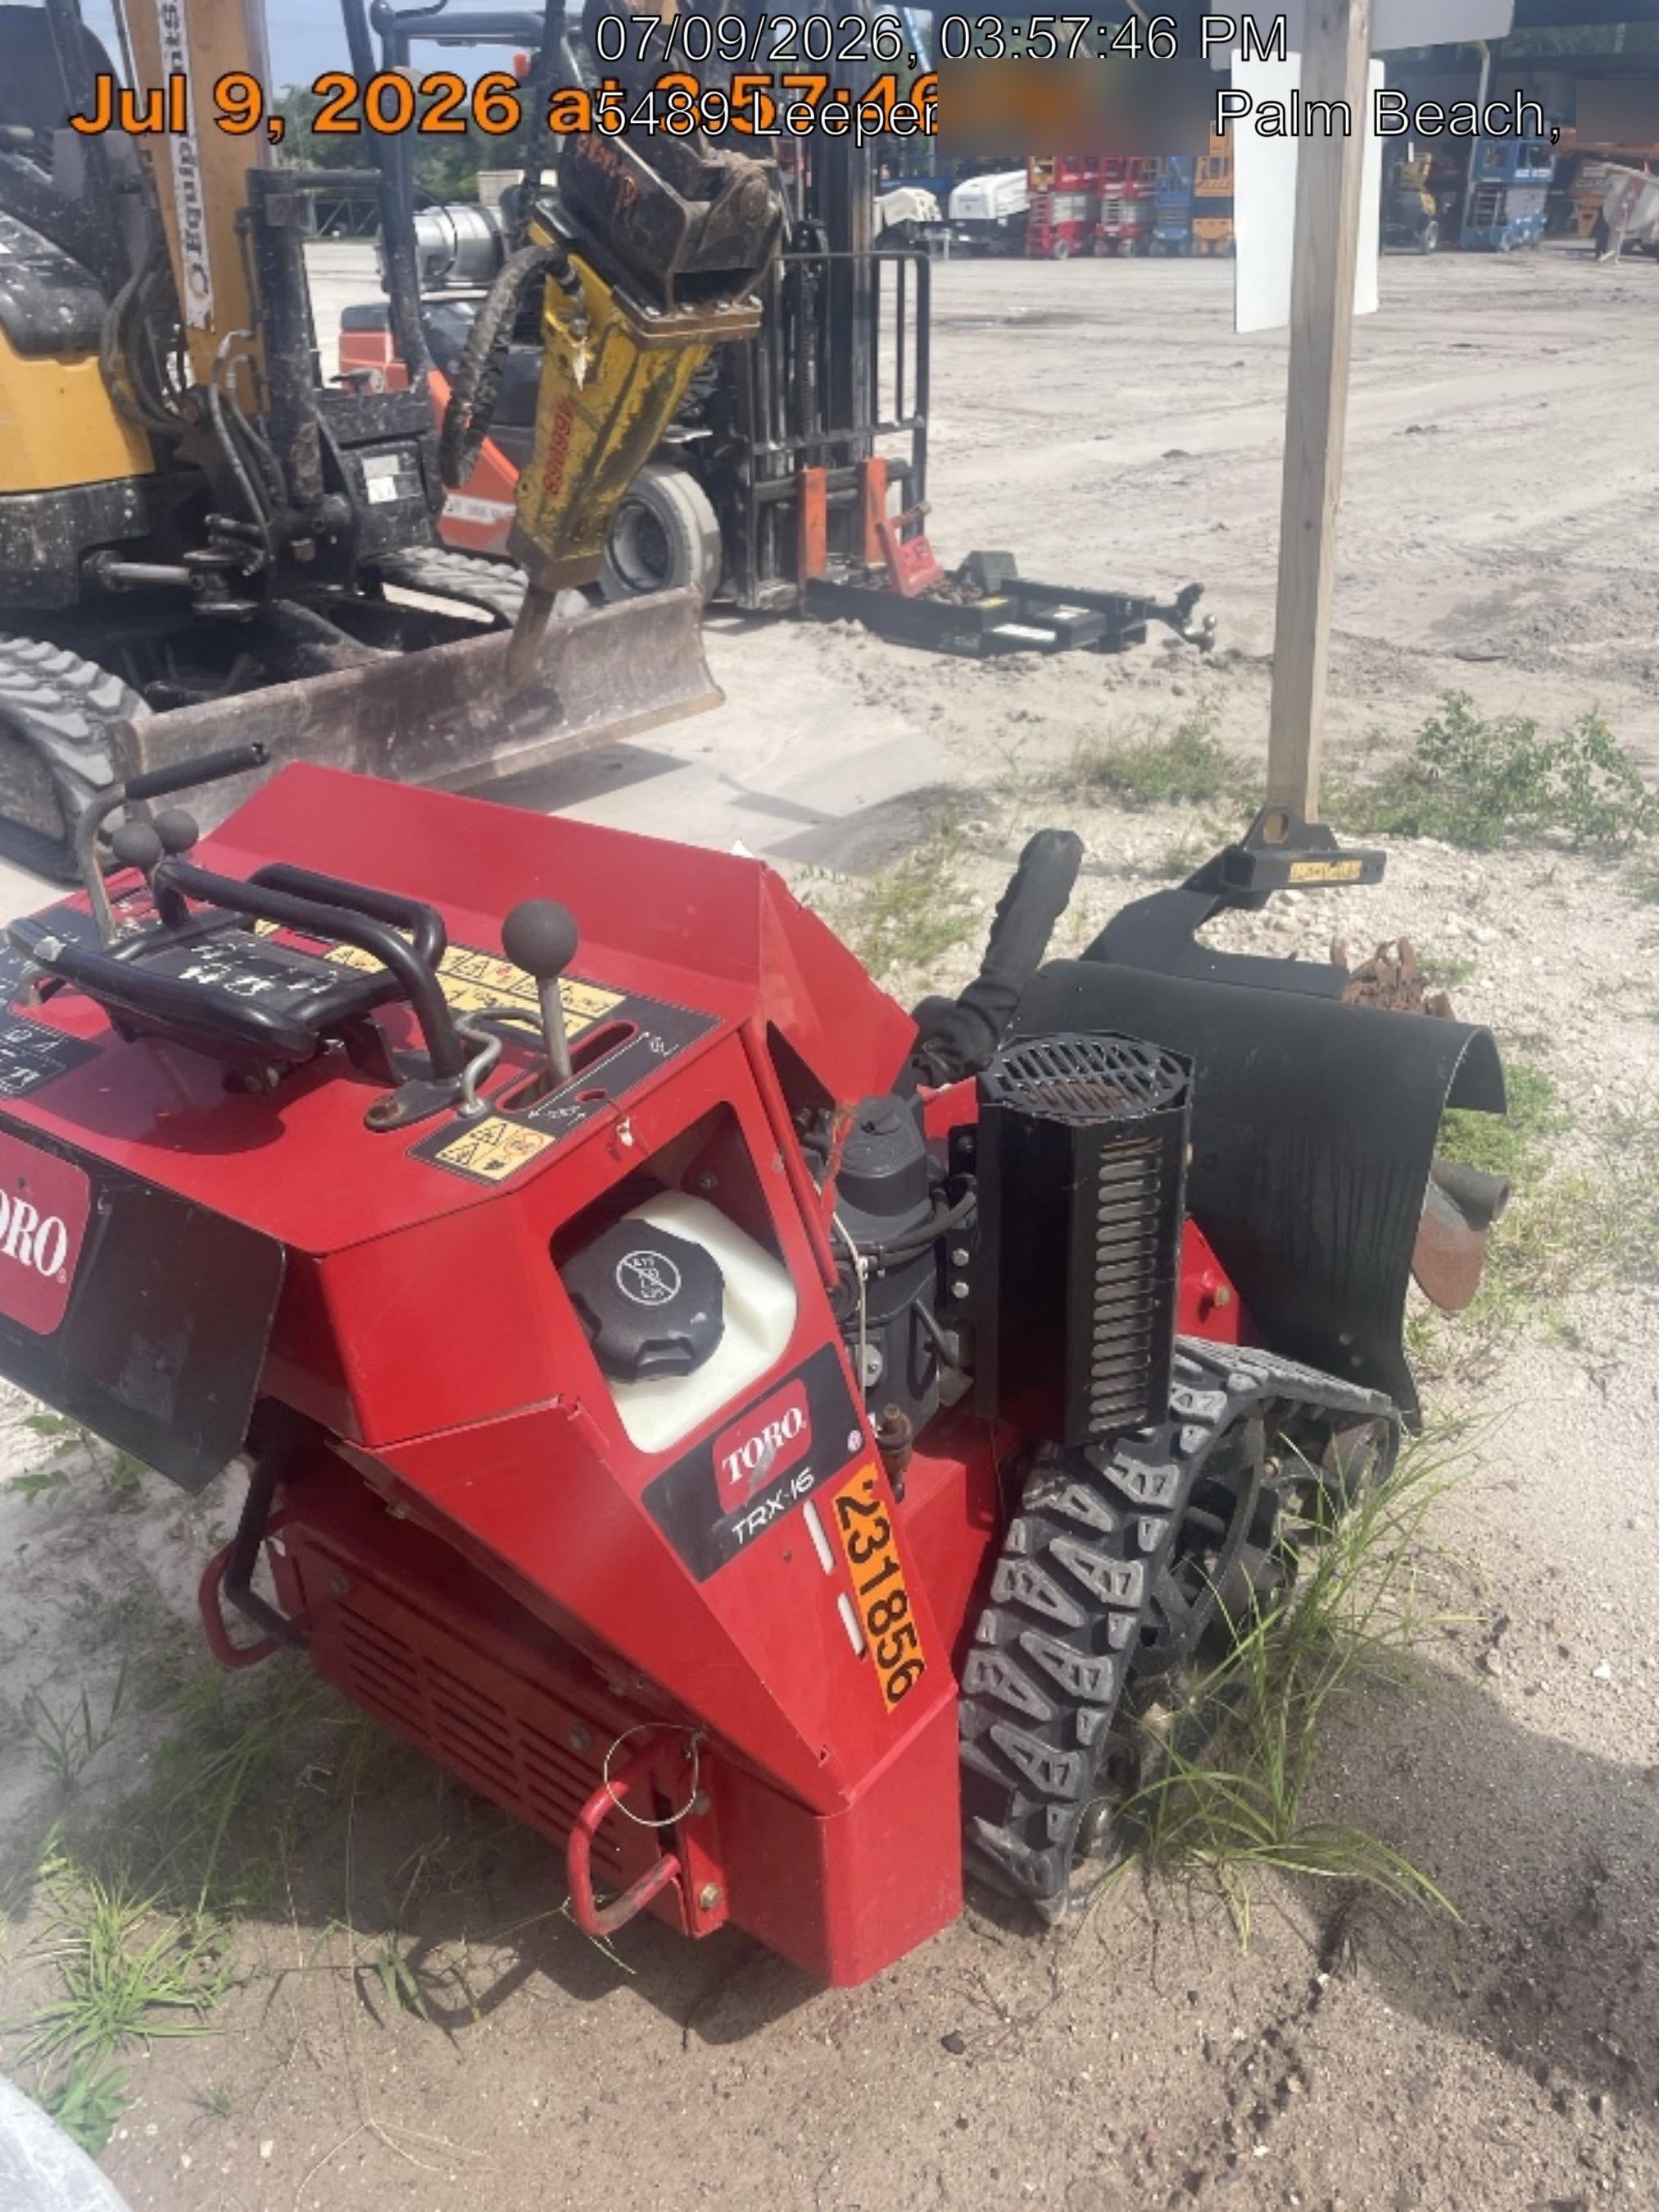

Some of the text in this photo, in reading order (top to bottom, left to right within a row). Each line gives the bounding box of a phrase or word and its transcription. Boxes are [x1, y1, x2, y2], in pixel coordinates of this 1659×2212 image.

[721, 1407, 805, 1485] TORO
[732, 1466, 814, 1544] TRX-16
[836, 1495, 926, 1703] 231856
